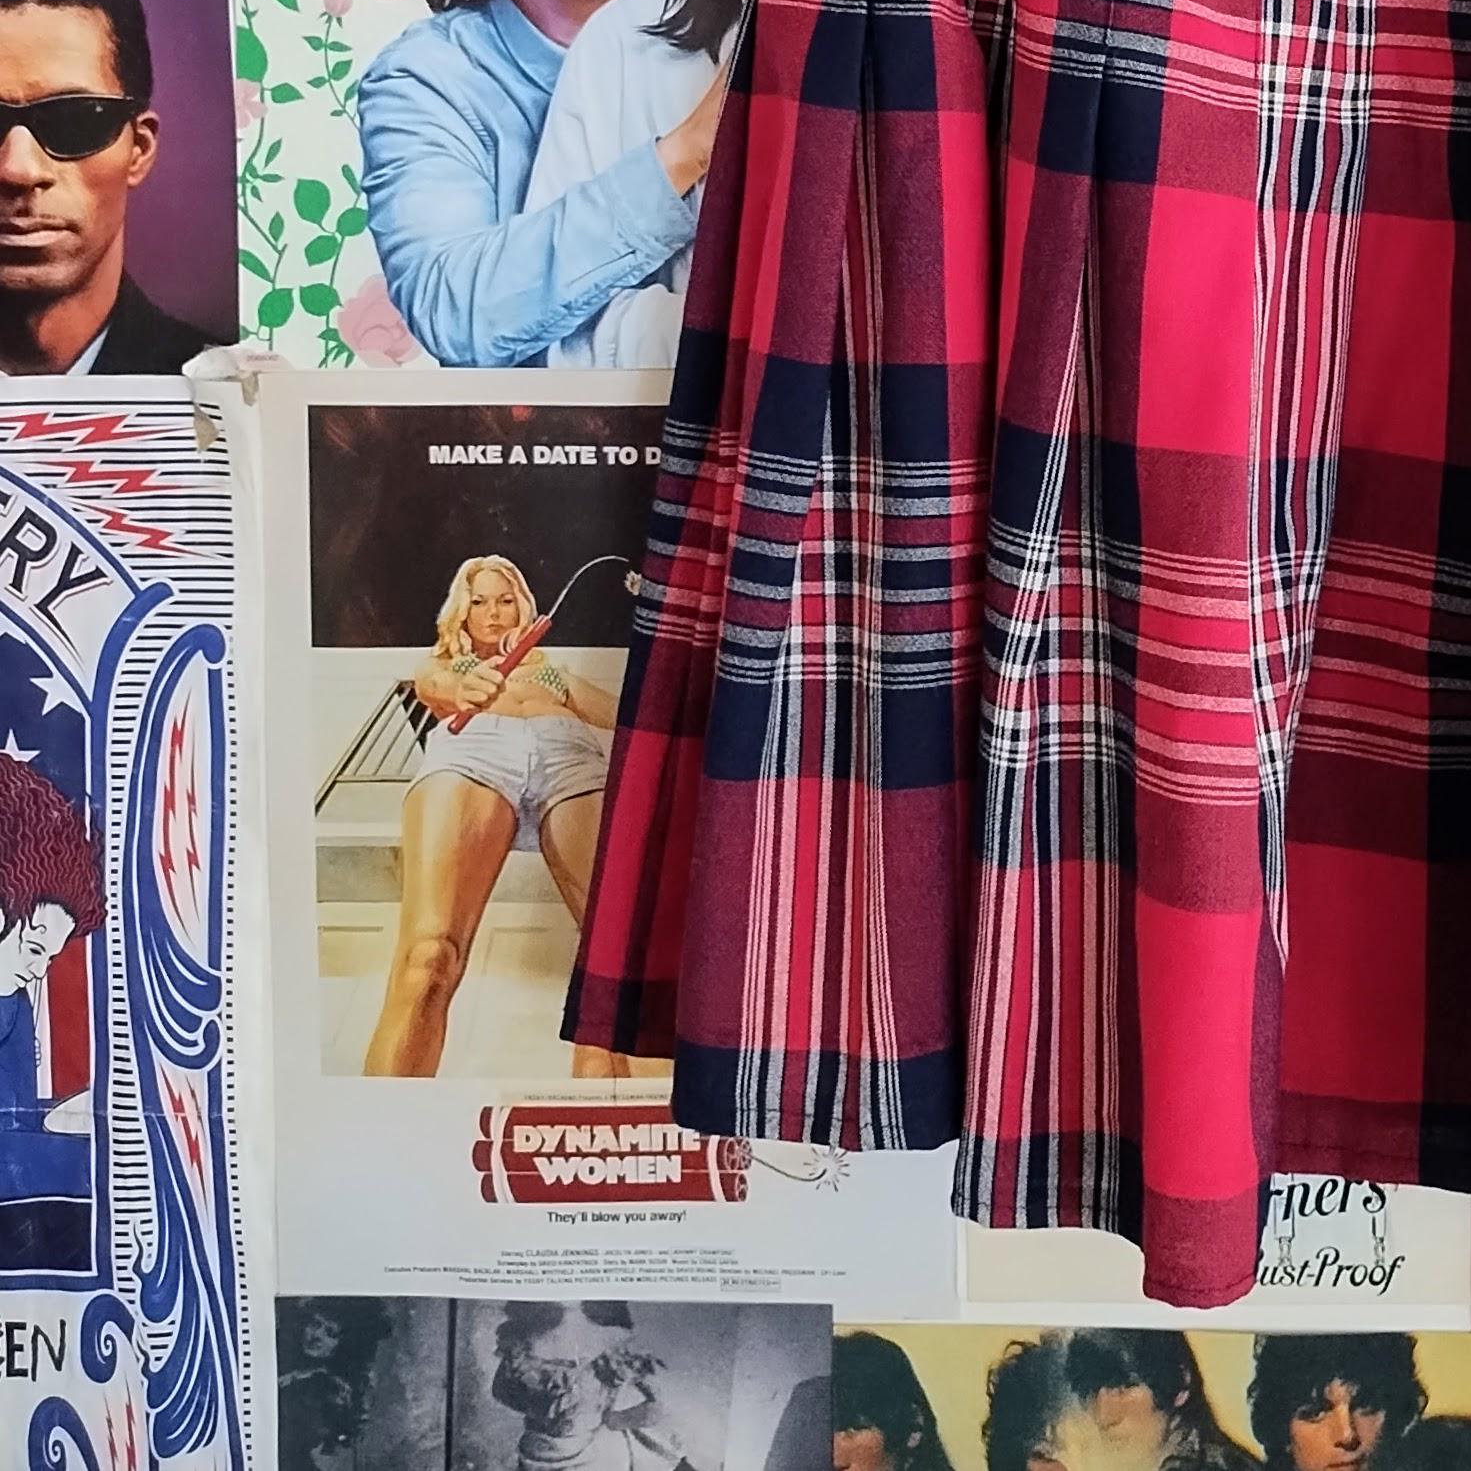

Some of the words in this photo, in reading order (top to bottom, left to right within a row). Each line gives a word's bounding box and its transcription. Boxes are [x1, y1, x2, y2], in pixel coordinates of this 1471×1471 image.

[428, 444, 503, 465] MAKE
[508, 445, 528, 465] A
[533, 444, 597, 465] DATE
[603, 445, 638, 466] TO
[0, 490, 114, 675] RY
[512, 1123, 701, 1153] DYNAMITE
[532, 1154, 683, 1186] WOMEN
[591, 1211, 620, 1223] blow
[624, 1212, 647, 1224] you
[1258, 1245, 1406, 1297] ust-Proof
[0, 1318, 67, 1382] EN
